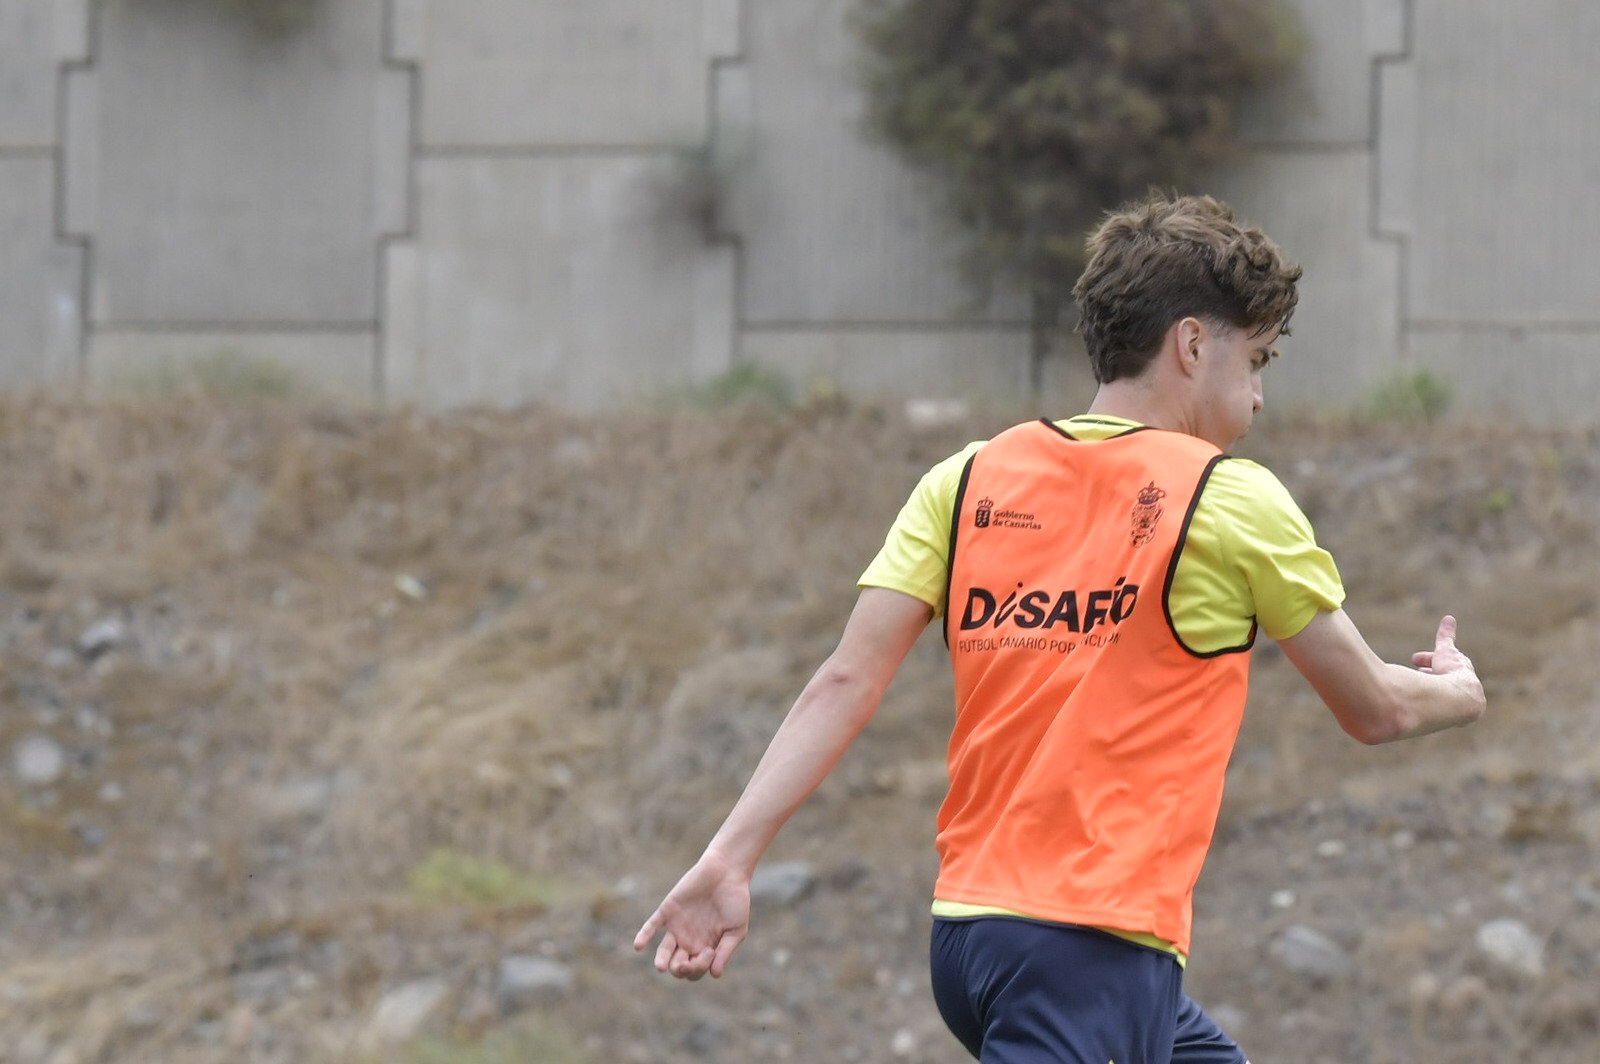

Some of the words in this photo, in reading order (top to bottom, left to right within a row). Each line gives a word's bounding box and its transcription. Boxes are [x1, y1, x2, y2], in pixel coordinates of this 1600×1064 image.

[994, 509, 1035, 521] Gobierno
[993, 519, 1003, 527] de
[1004, 519, 1042, 530] Canarias
